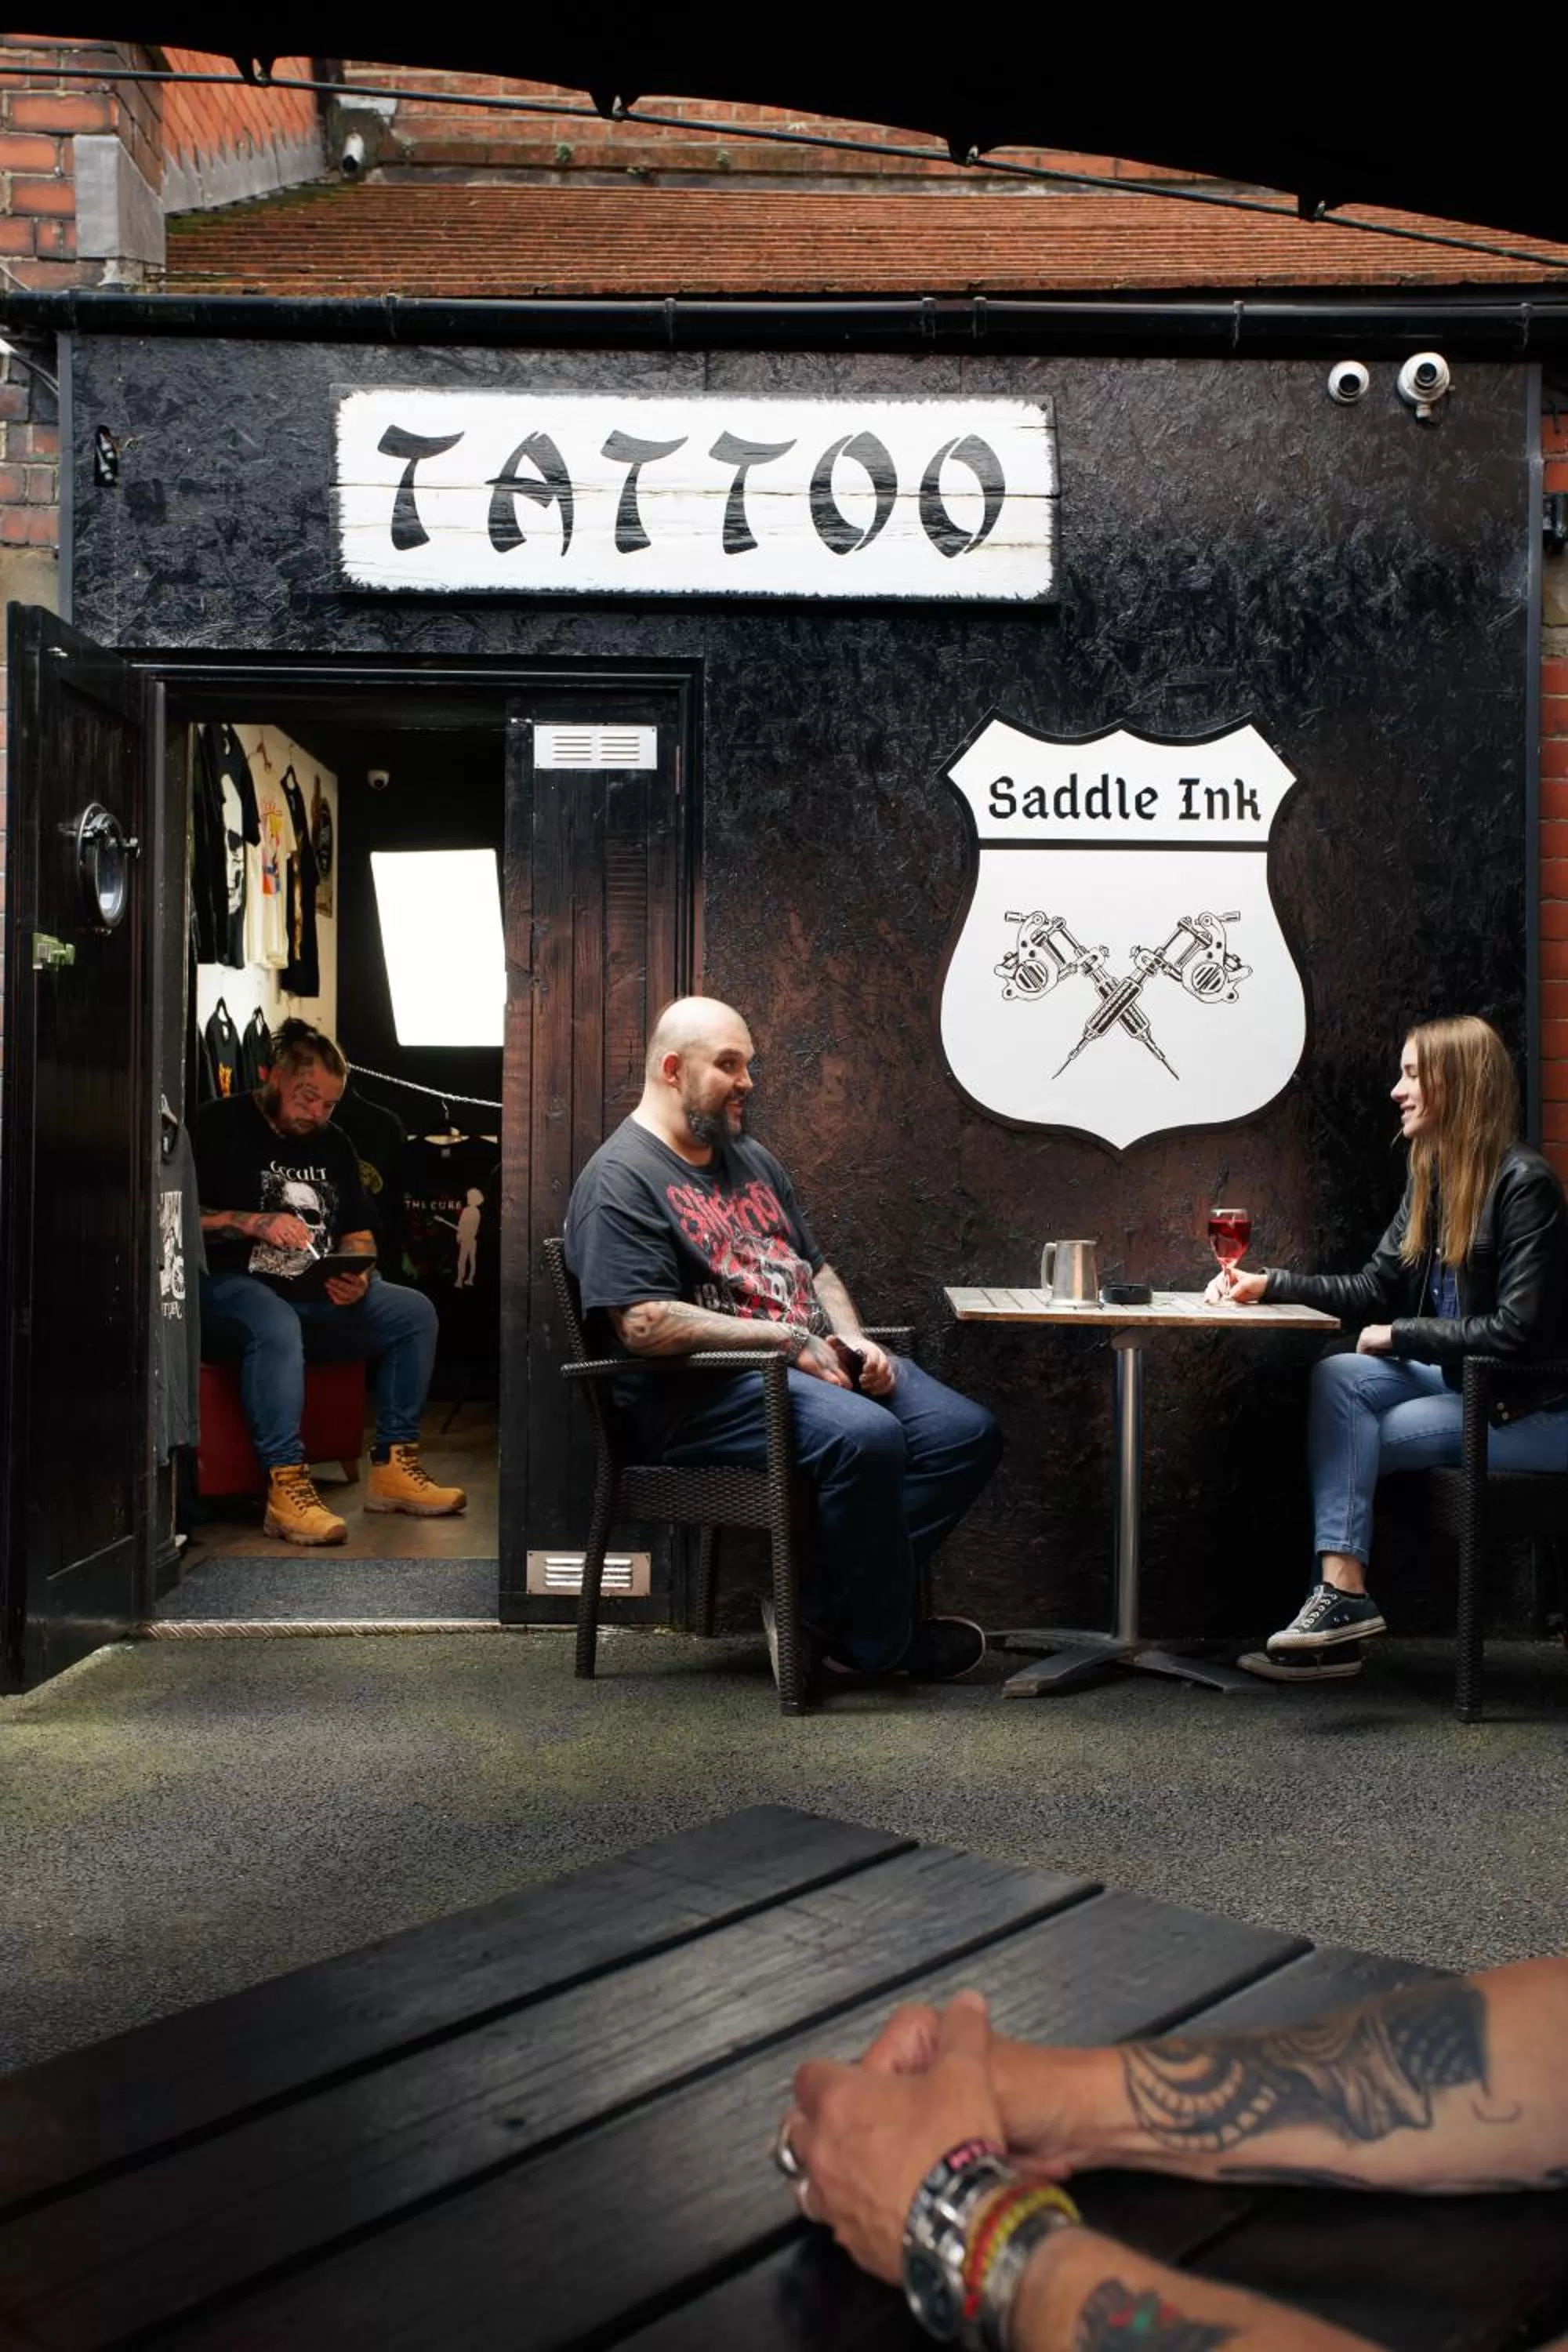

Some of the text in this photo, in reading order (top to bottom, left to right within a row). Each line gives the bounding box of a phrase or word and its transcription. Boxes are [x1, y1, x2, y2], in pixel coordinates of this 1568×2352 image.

[378, 423, 1005, 558] TATTOO
[989, 772, 1261, 822] Saddle Ink
